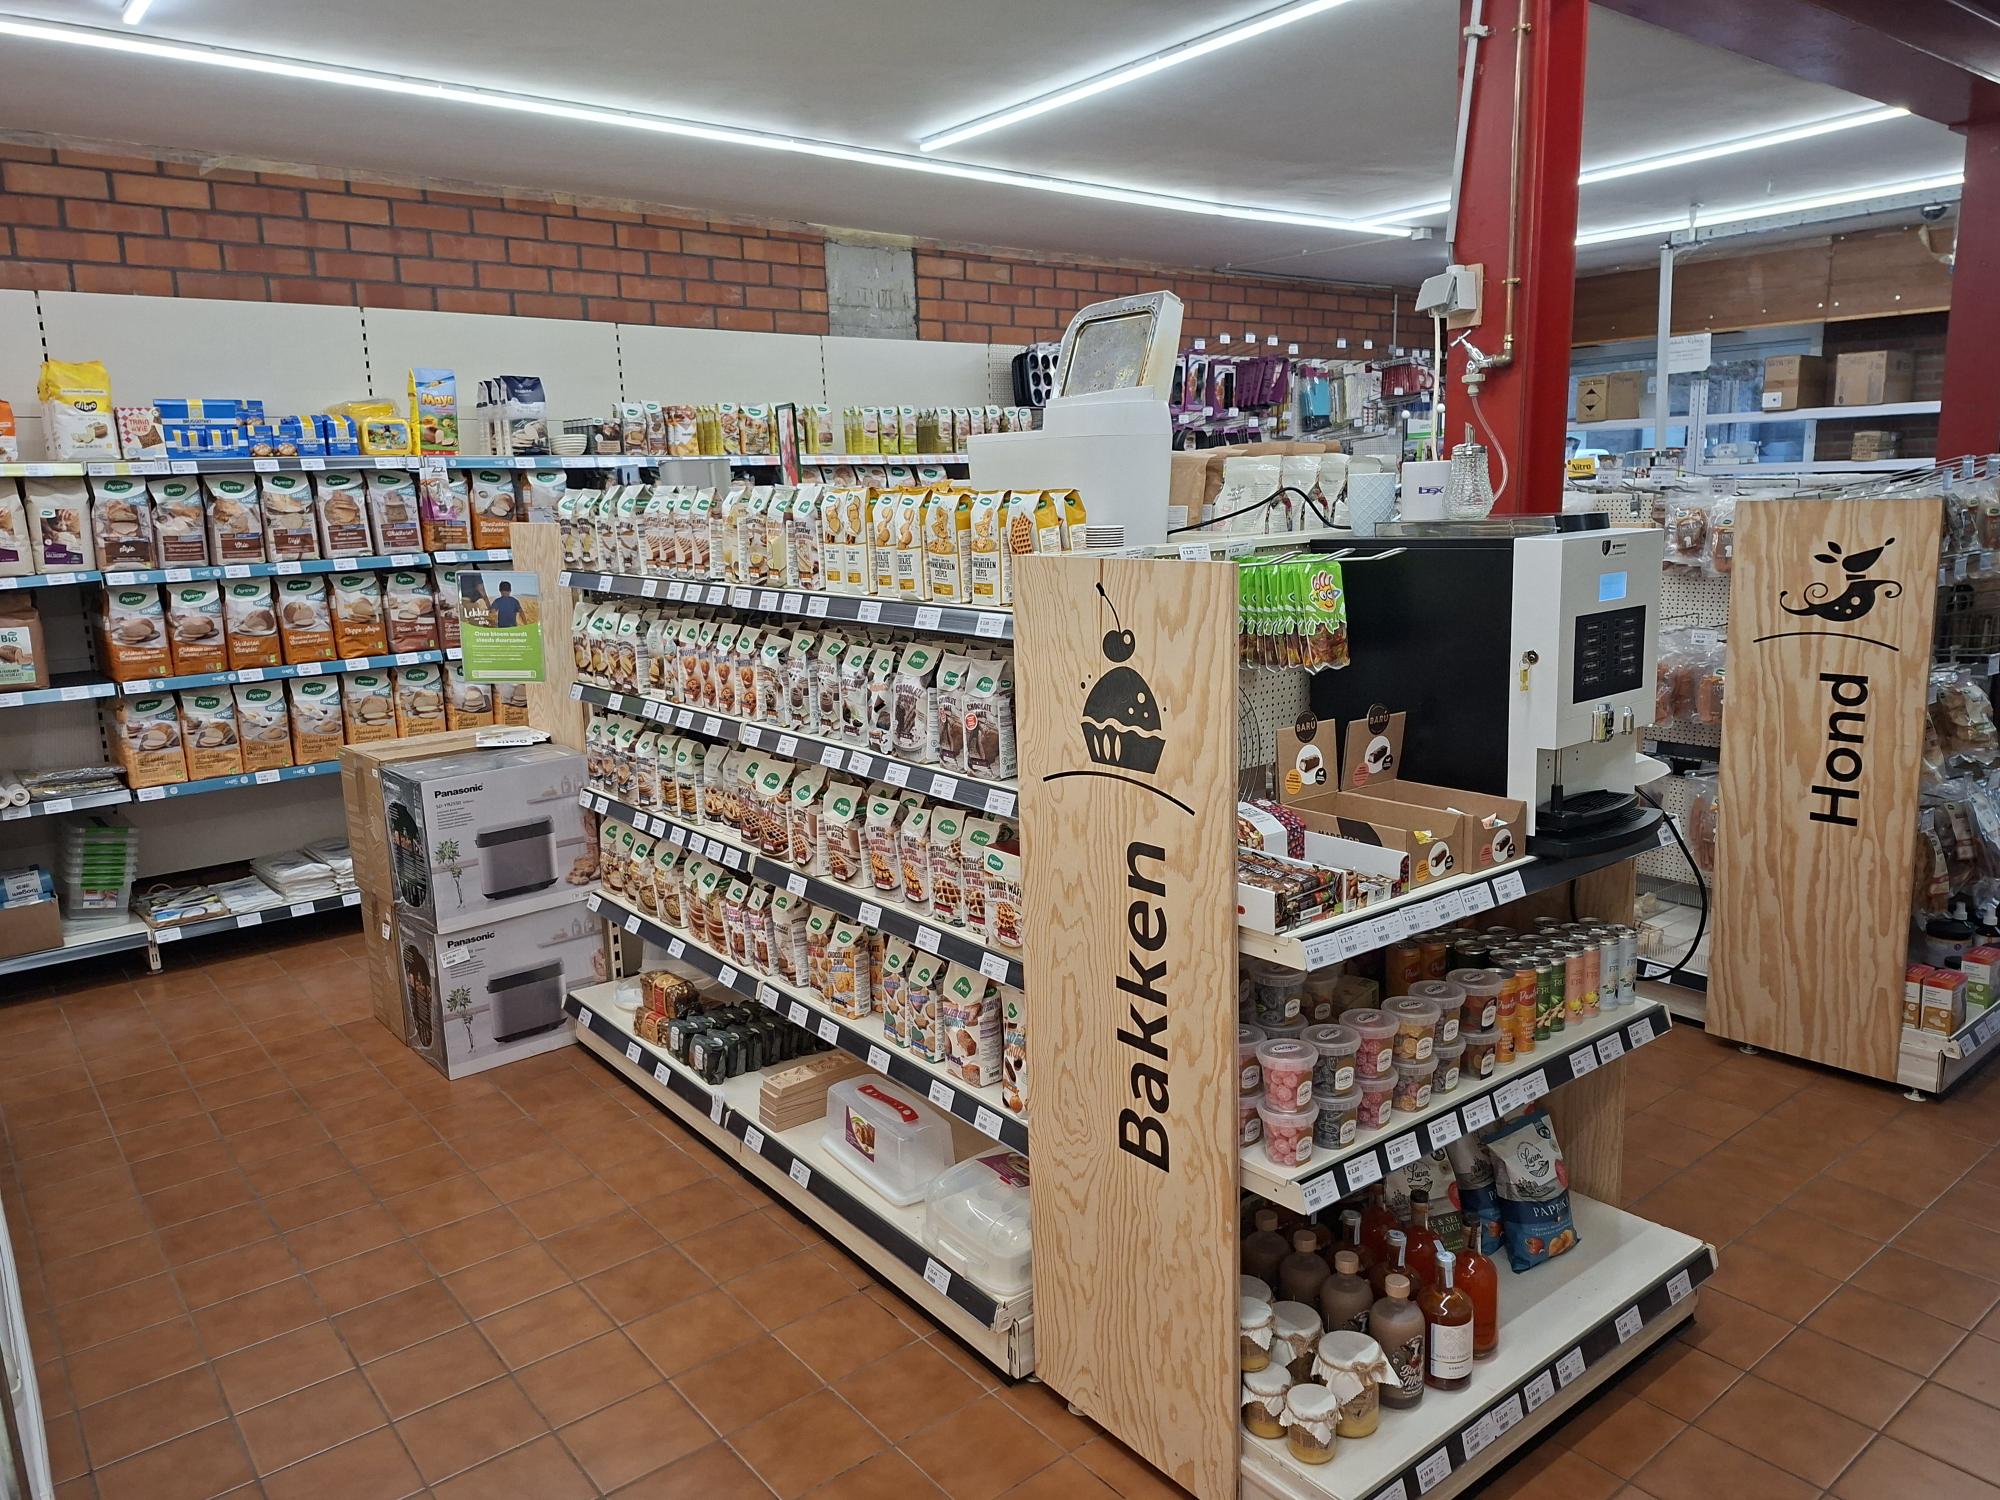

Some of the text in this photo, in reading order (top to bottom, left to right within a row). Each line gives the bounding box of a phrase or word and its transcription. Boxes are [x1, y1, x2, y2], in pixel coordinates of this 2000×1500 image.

[75, 401, 97, 411] dibro
[421, 392, 455, 406] Maya
[1571, 461, 1591, 472] Nitro
[464, 607, 489, 618] Lekker
[1295, 718, 1317, 733] BARÚ
[1809, 671, 1869, 827] Hond
[434, 783, 484, 799] Panasonic
[447, 931, 496, 949] Panasonic
[1114, 839, 1170, 1173] Bakken
[1520, 1147, 1544, 1168] Lucien
[1406, 1164, 1431, 1182] Lucien
